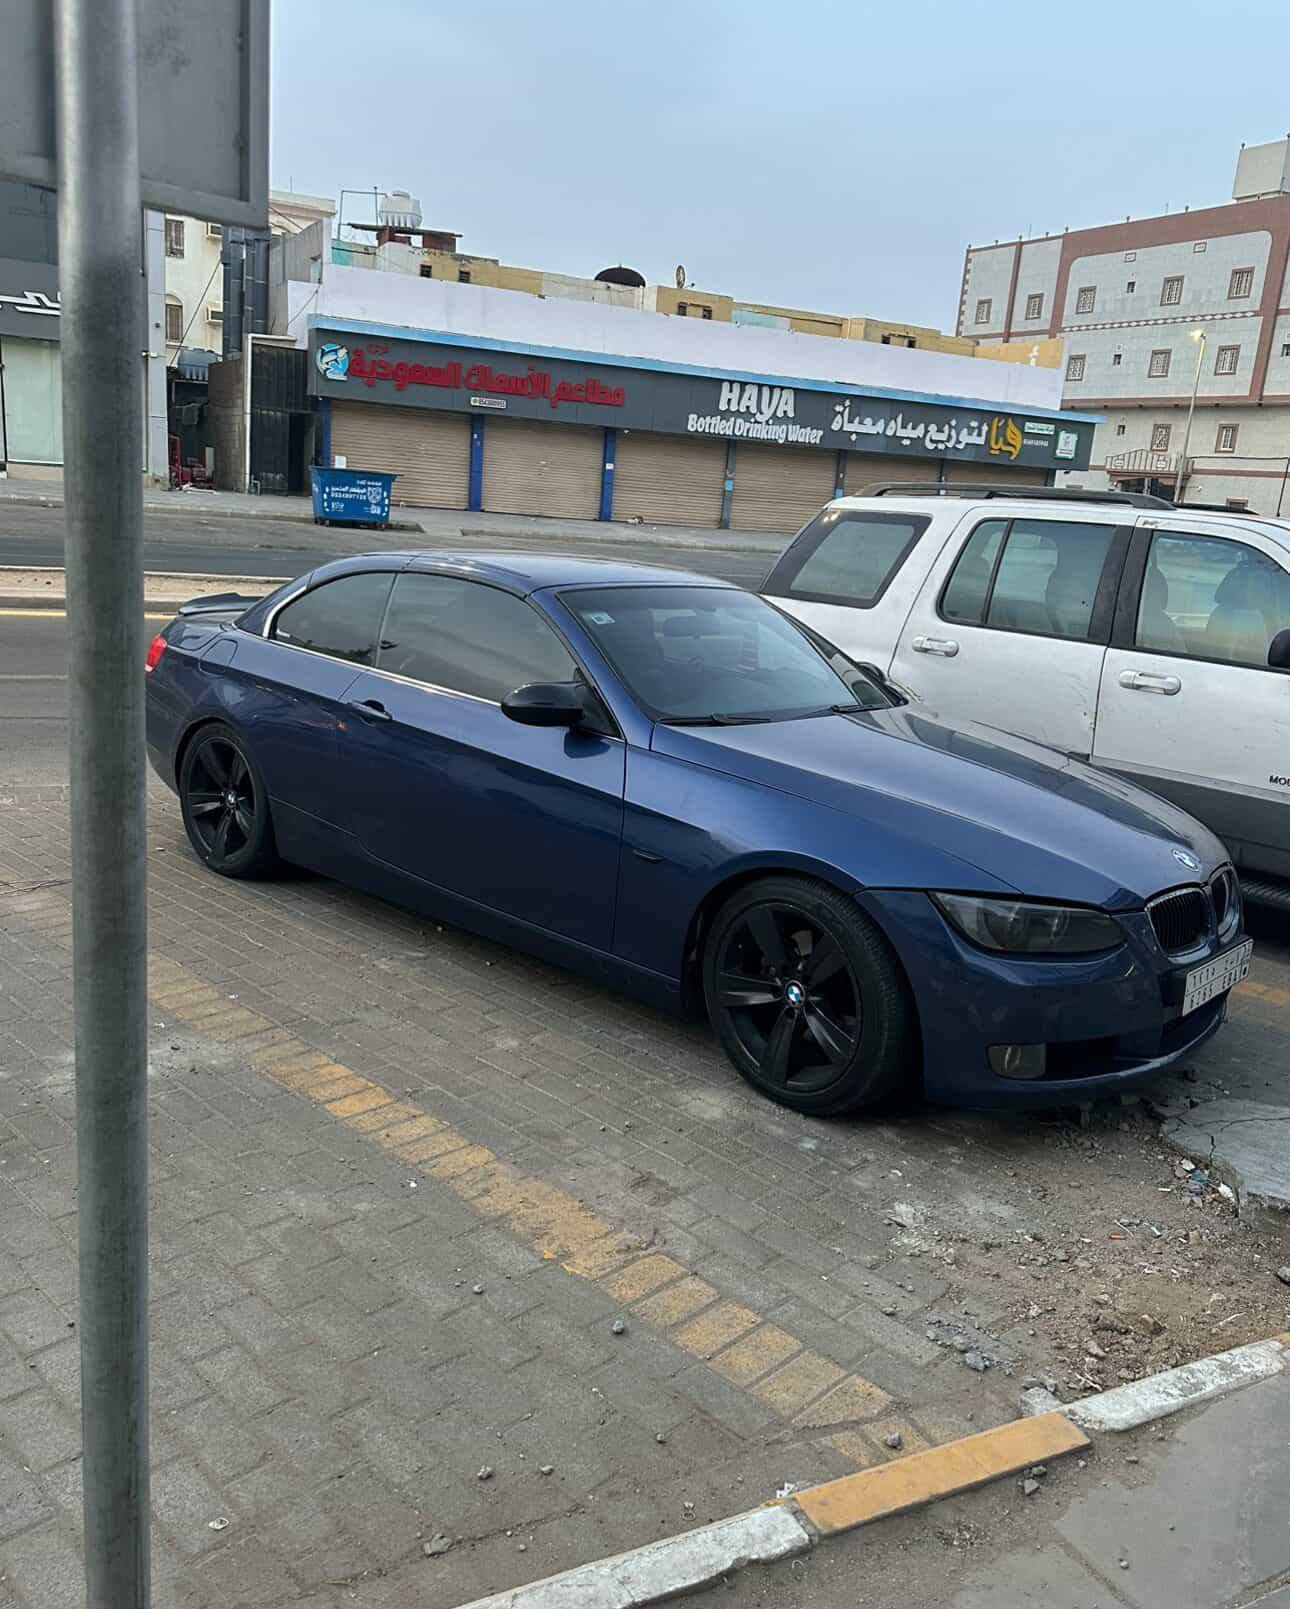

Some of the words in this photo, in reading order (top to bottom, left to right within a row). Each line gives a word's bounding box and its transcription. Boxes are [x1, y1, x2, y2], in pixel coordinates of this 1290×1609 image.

[349, 349, 463, 390] السعودية
[464, 364, 550, 399] الأسماك
[552, 378, 625, 408] مطاعم
[719, 381, 795, 422] HAYA
[687, 413, 735, 435] Bottled
[734, 417, 785, 443] Drinking
[787, 423, 824, 444] Water
[831, 398, 885, 441] معبأة
[885, 412, 926, 446] مياه
[924, 418, 989, 450] لتوزيع
